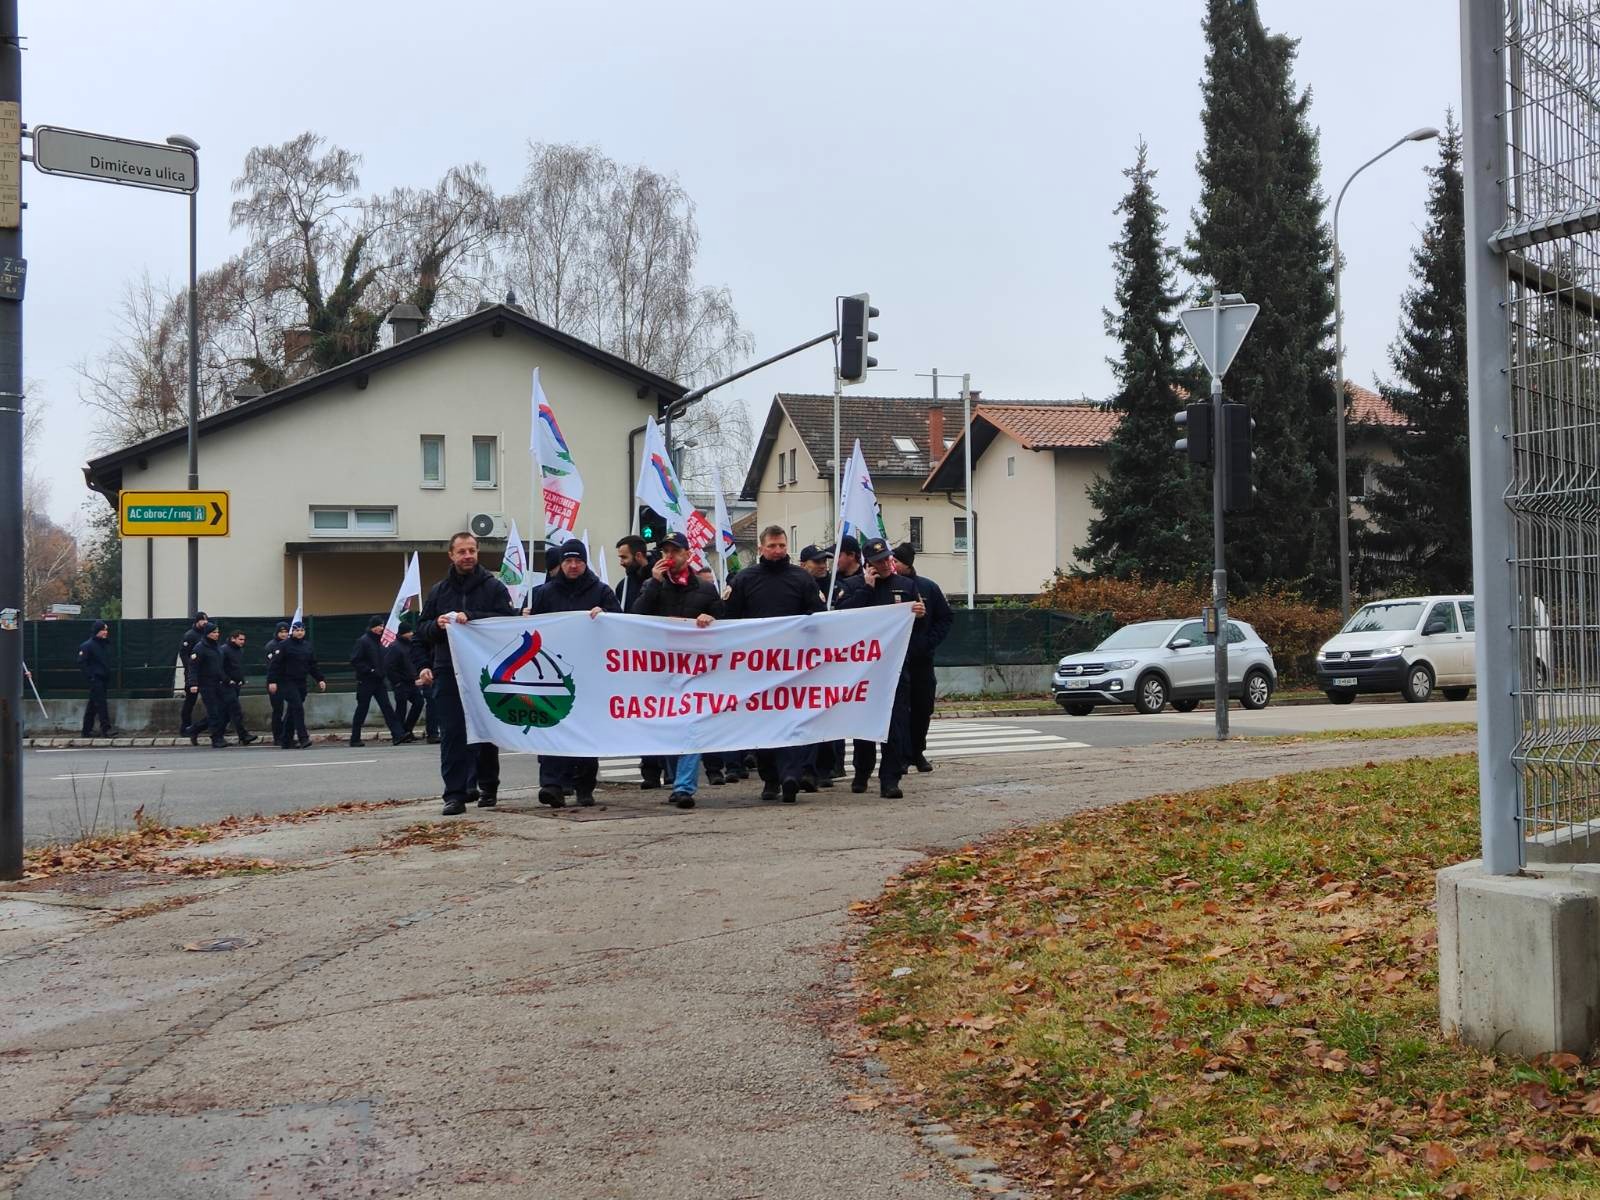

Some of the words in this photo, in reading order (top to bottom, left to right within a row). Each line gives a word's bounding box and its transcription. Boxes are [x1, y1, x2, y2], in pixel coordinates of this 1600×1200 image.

[90, 156, 152, 177] Dimičeva
[155, 166, 185, 182] ulica
[129, 508, 142, 519] AC
[605, 648, 723, 676] SINDIKAT
[507, 709, 550, 724] SPGS
[609, 691, 739, 719] GASILSTVA
